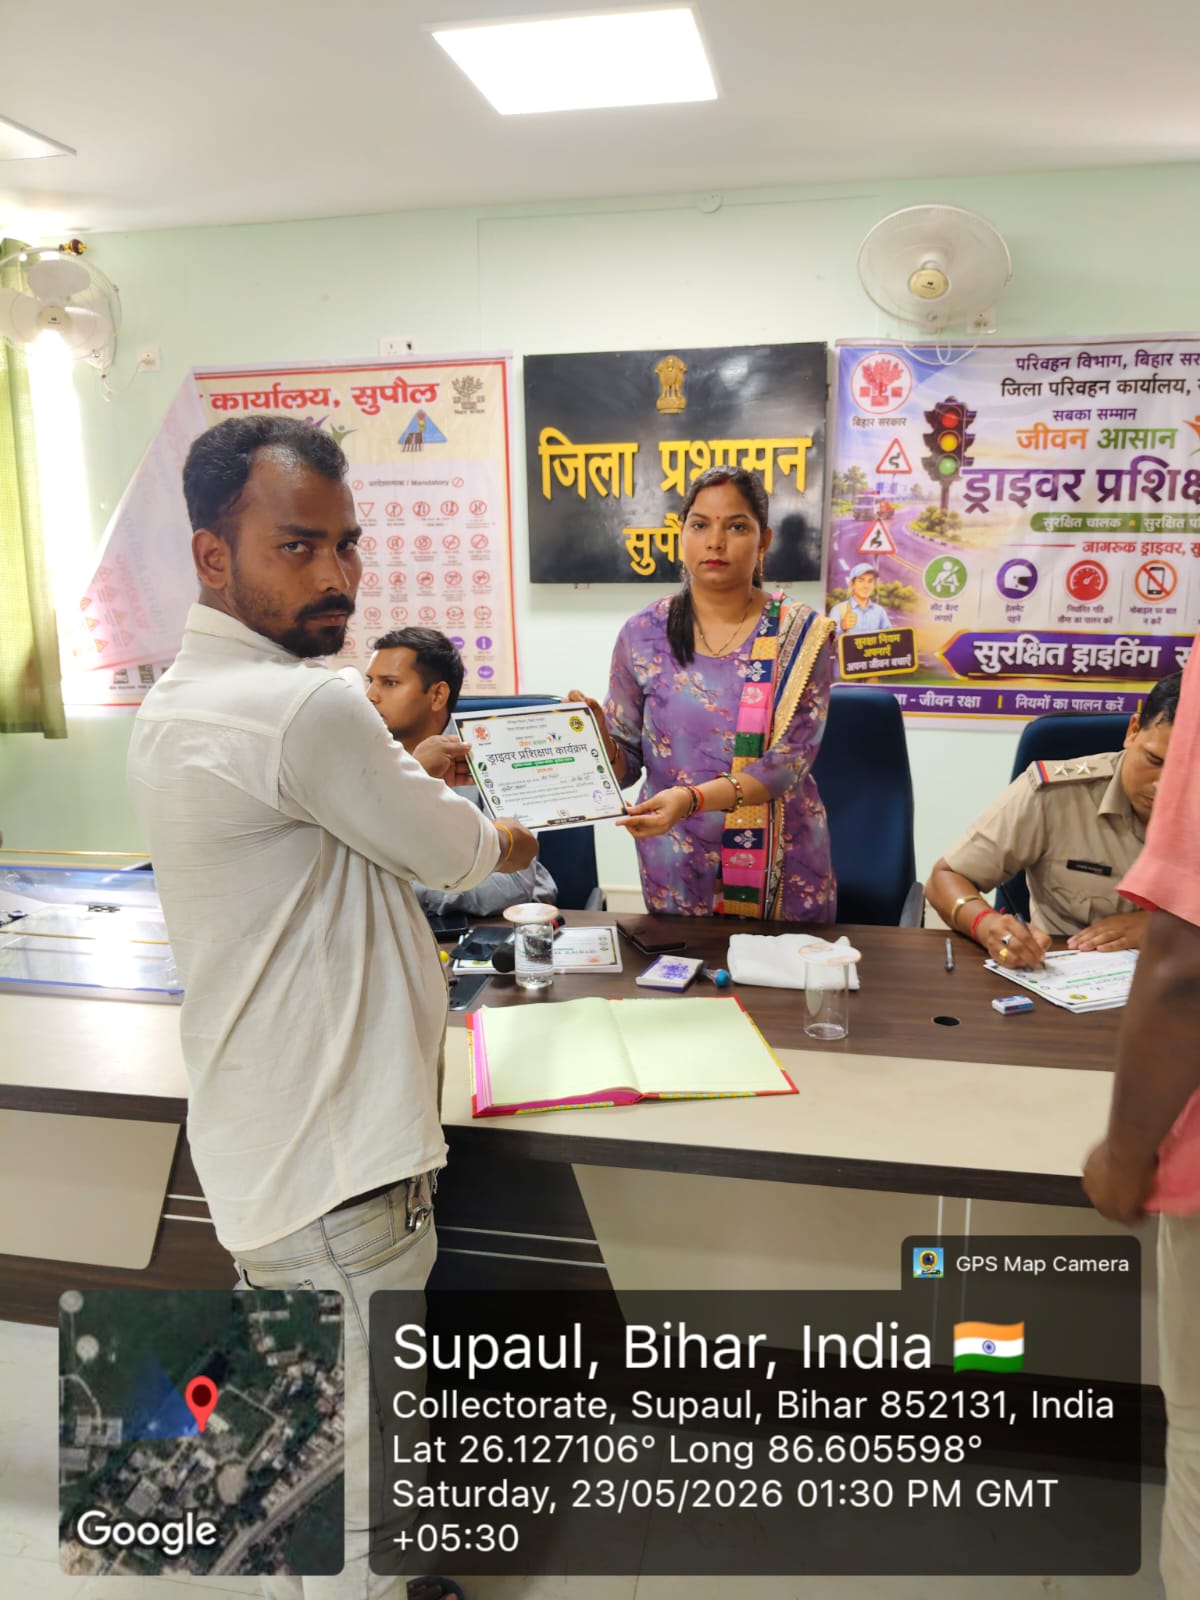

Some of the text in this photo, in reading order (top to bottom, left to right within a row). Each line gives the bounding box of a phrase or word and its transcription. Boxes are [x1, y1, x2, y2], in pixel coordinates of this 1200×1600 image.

[1016, 350, 1200, 372] परिवहन विभाग, बिहार सर
[209, 376, 440, 415] कार्यालय, सुपौल
[1001, 377, 1042, 397] जिला
[1049, 376, 1111, 398] परिवहन
[1117, 373, 1191, 396] कार्यालय,
[1053, 408, 1137, 421] सबका सम्मान
[1016, 422, 1178, 450] जीवन आसान
[538, 427, 638, 500] जिला
[961, 455, 1200, 514] ड्राइवर प्रशिक्ष
[1042, 514, 1082, 531] सुरक्षित
[1086, 517, 1122, 528] चालक
[1143, 515, 1185, 531] सुरक्षित
[623, 512, 684, 576] सुपौ
[973, 634, 1068, 674] सुरक्षित
[1072, 637, 1162, 673] ड्राइविंग
[919, 690, 954, 707] जीवन
[957, 695, 982, 708] रक्षा
[1015, 694, 1124, 711] नियमों का पालन करें
[486, 751, 517, 766] ड्राइवर
[518, 747, 553, 760] प्रशिक्षण
[555, 743, 588, 755] कार्यक्रम
